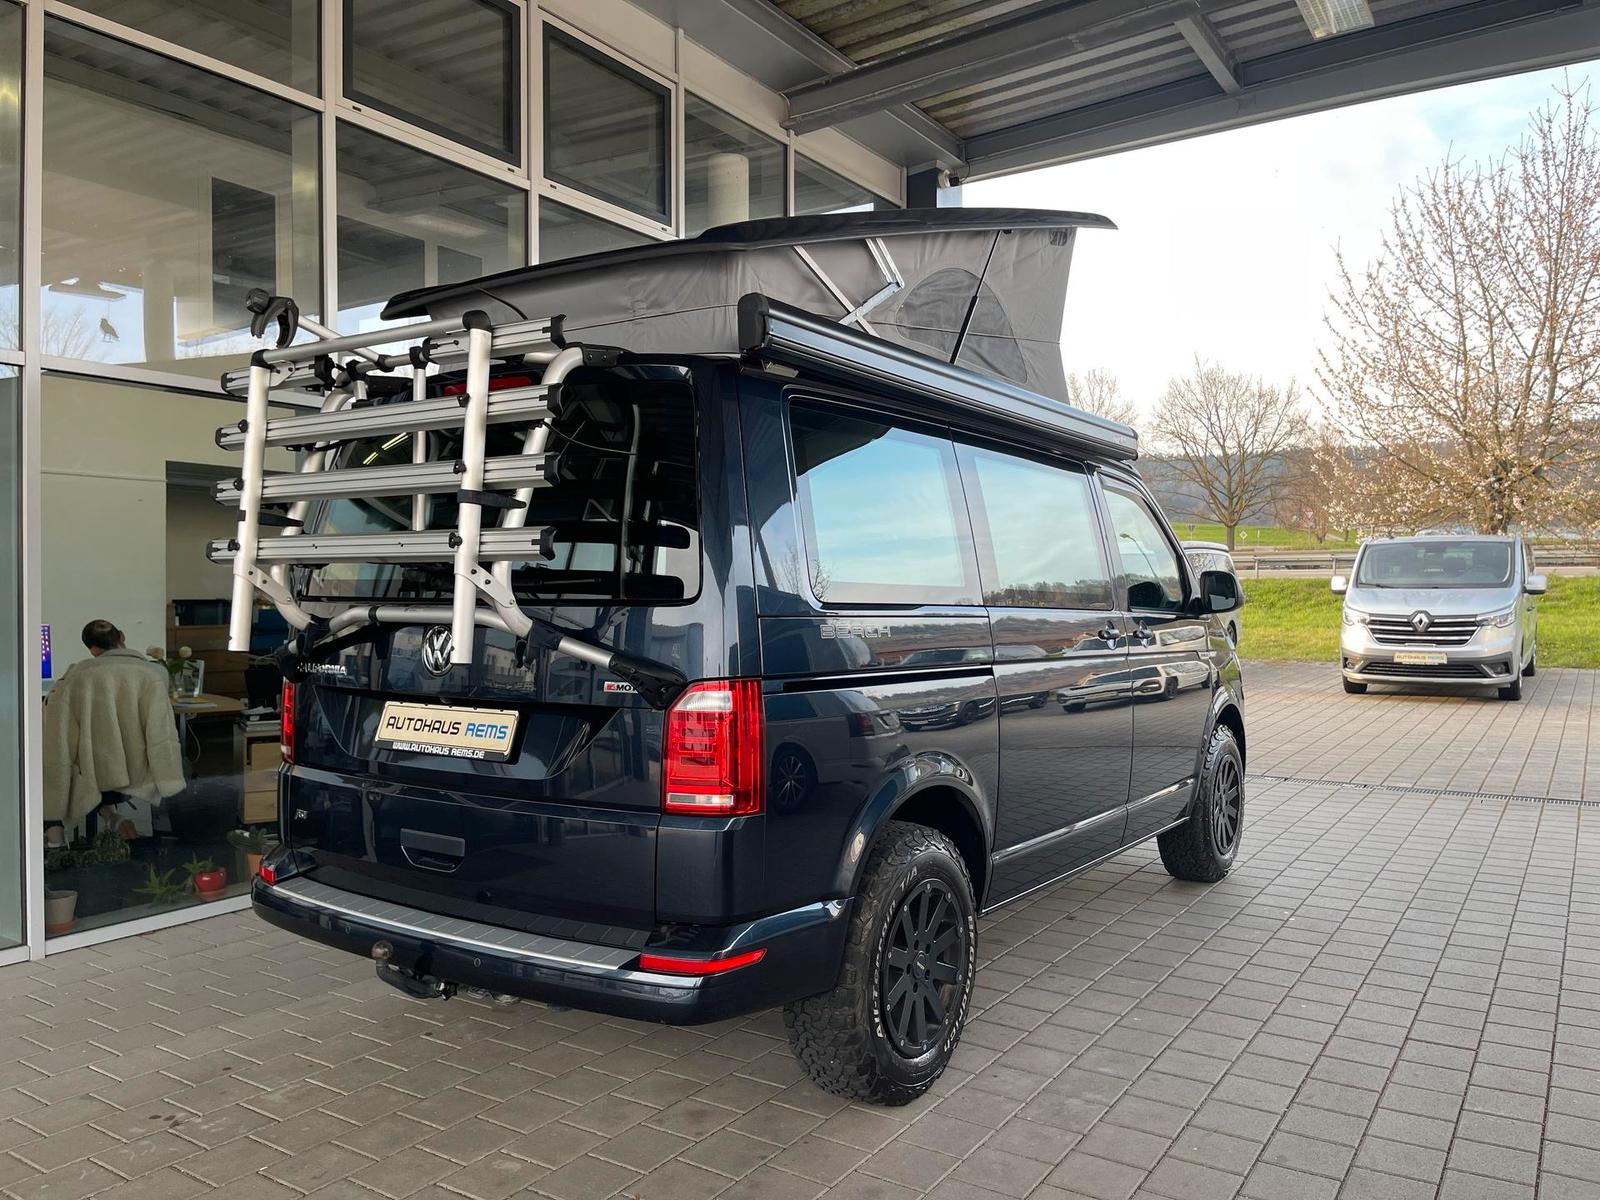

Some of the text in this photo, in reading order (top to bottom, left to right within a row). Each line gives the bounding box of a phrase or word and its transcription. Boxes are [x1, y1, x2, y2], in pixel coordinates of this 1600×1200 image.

[819, 623, 891, 639] BEACH
[385, 716, 509, 740] AUTOHAUS REMS
[392, 741, 486, 759] WWW.AUTOHAUS REMS.DE
[899, 865, 918, 892] T/A
